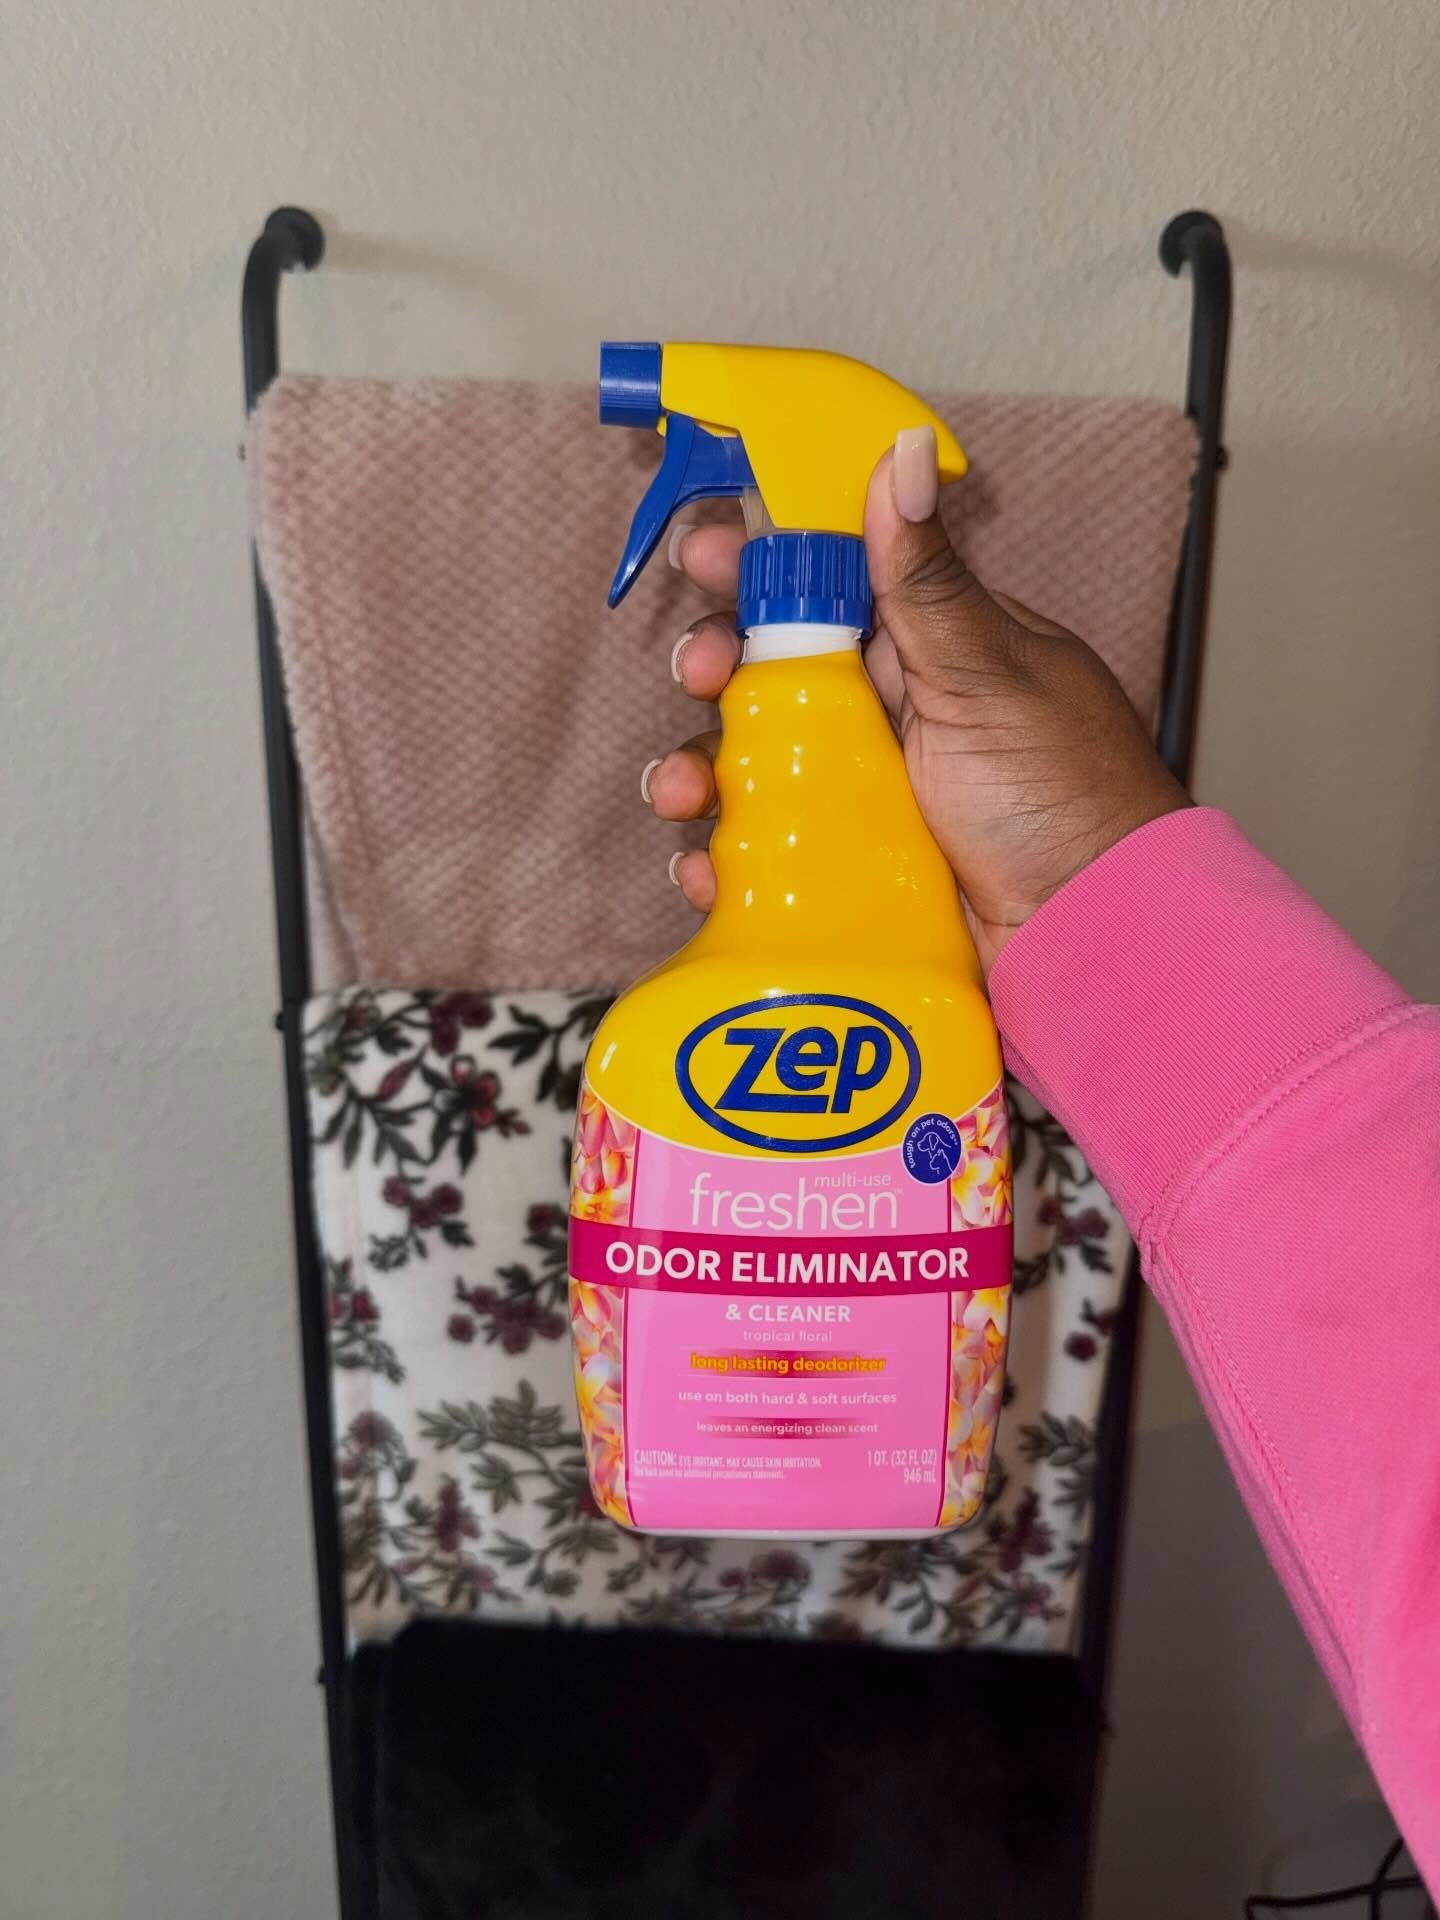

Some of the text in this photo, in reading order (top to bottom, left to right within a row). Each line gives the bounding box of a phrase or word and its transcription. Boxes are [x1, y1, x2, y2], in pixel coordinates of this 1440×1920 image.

[713, 1025, 892, 1114] Zep
[906, 1140, 916, 1169] tough
[911, 1126, 921, 1138] on
[920, 1118, 935, 1129] pet
[814, 1172, 891, 1188] multi-use
[689, 1172, 898, 1231] freshen
[605, 1240, 969, 1284] ODOR ELIMINATOR
[725, 1303, 852, 1322] & CLEANER
[743, 1330, 833, 1344] tropical floral
[690, 1352, 886, 1375] long lasting deodorizer
[678, 1391, 897, 1405] use on both hard & soft surfaces
[696, 1420, 879, 1436] leaves an energizing clean scent
[633, 1448, 677, 1466] CAUTION:
[867, 1450, 872, 1466] 1
[903, 1468, 922, 1483] 946
